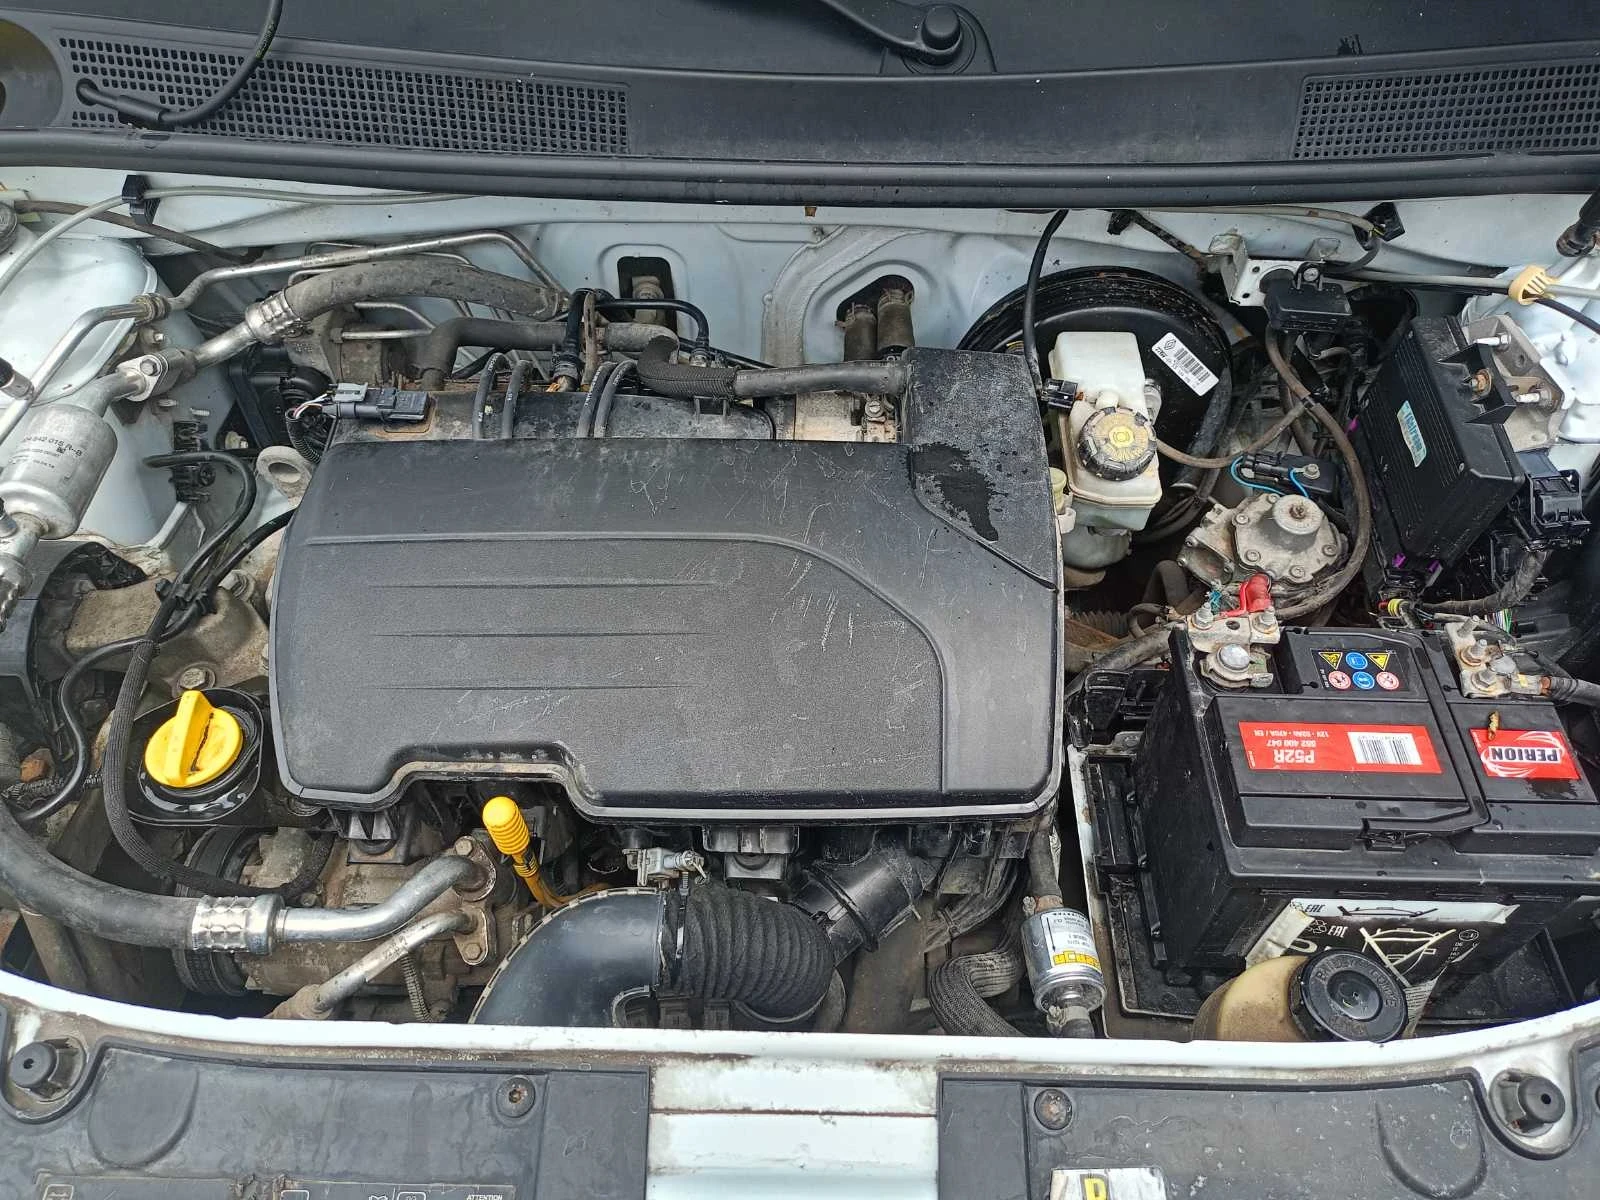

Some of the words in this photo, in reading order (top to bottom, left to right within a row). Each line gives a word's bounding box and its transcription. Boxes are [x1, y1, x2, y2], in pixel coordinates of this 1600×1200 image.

[1283, 739, 1299, 747] 400
[1300, 739, 1316, 747] 552
[1273, 749, 1315, 764] P52R
[1490, 747, 1558, 762] PERION
